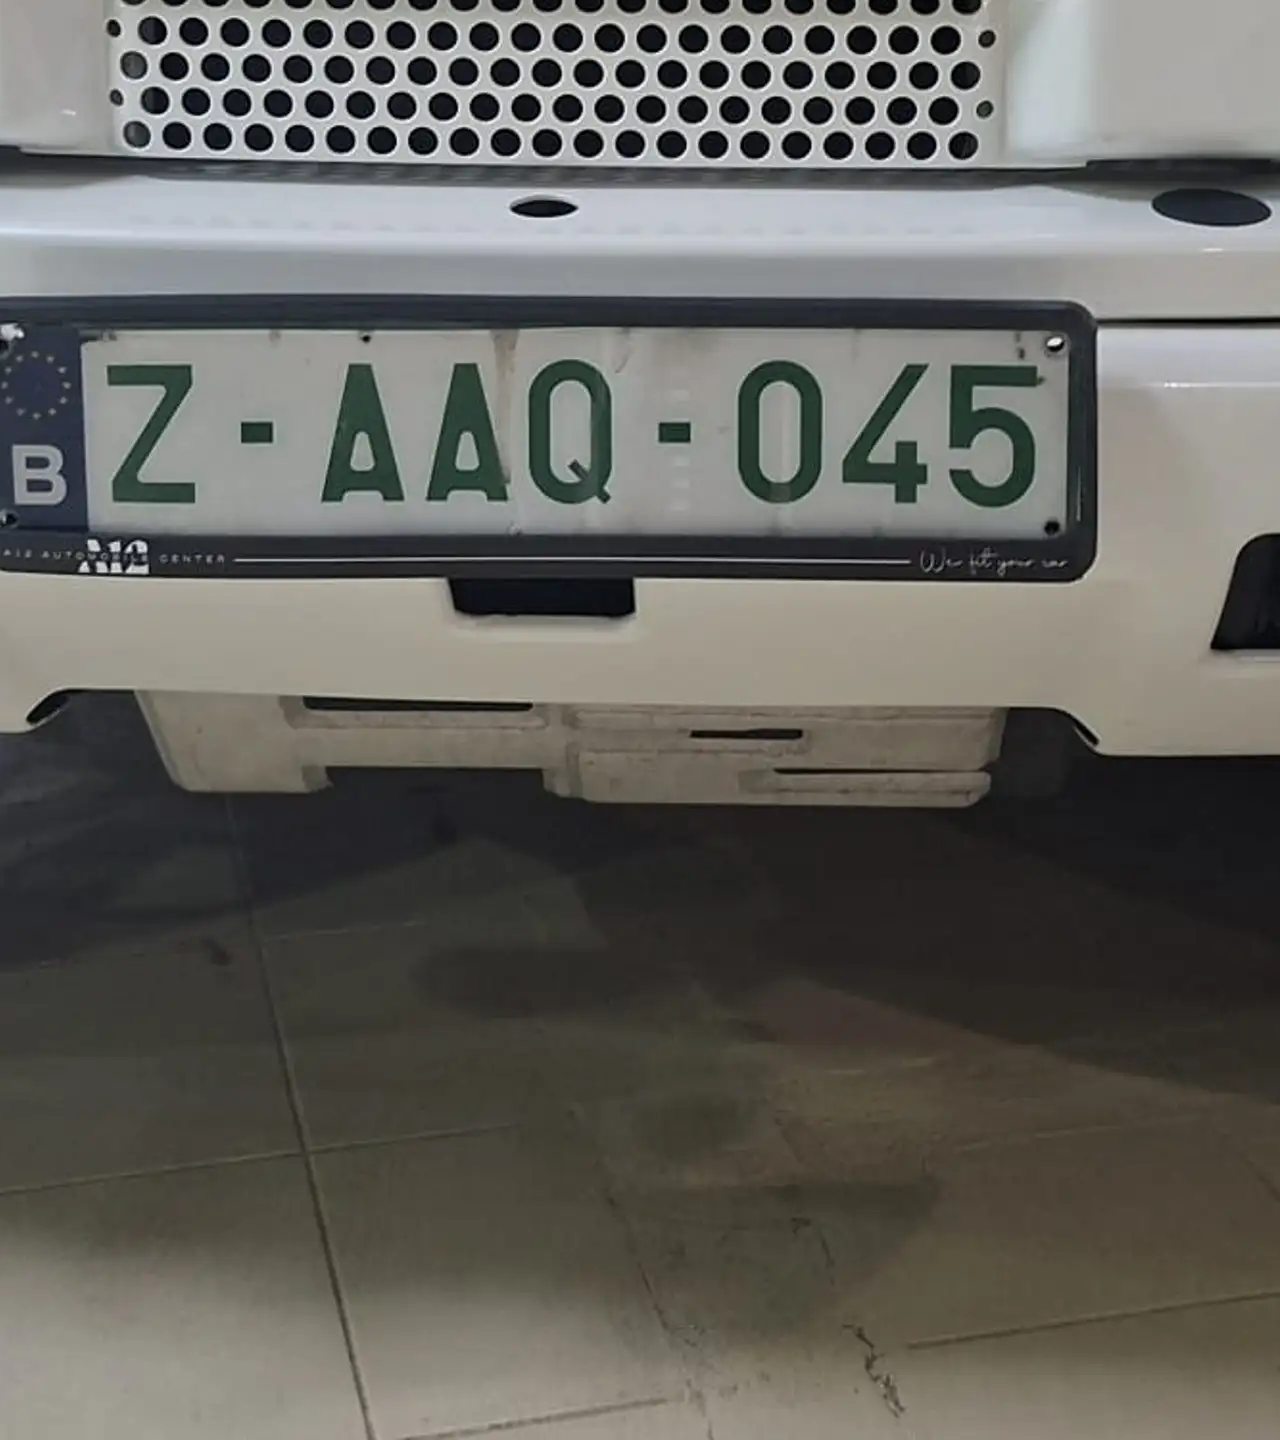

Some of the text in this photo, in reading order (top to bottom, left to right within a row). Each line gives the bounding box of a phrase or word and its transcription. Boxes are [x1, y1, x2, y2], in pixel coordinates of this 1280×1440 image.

[107, 359, 1037, 508] Z-AAQ-045
[12, 444, 68, 506] B
[159, 553, 225, 565] CENTER
[920, 547, 963, 573] We
